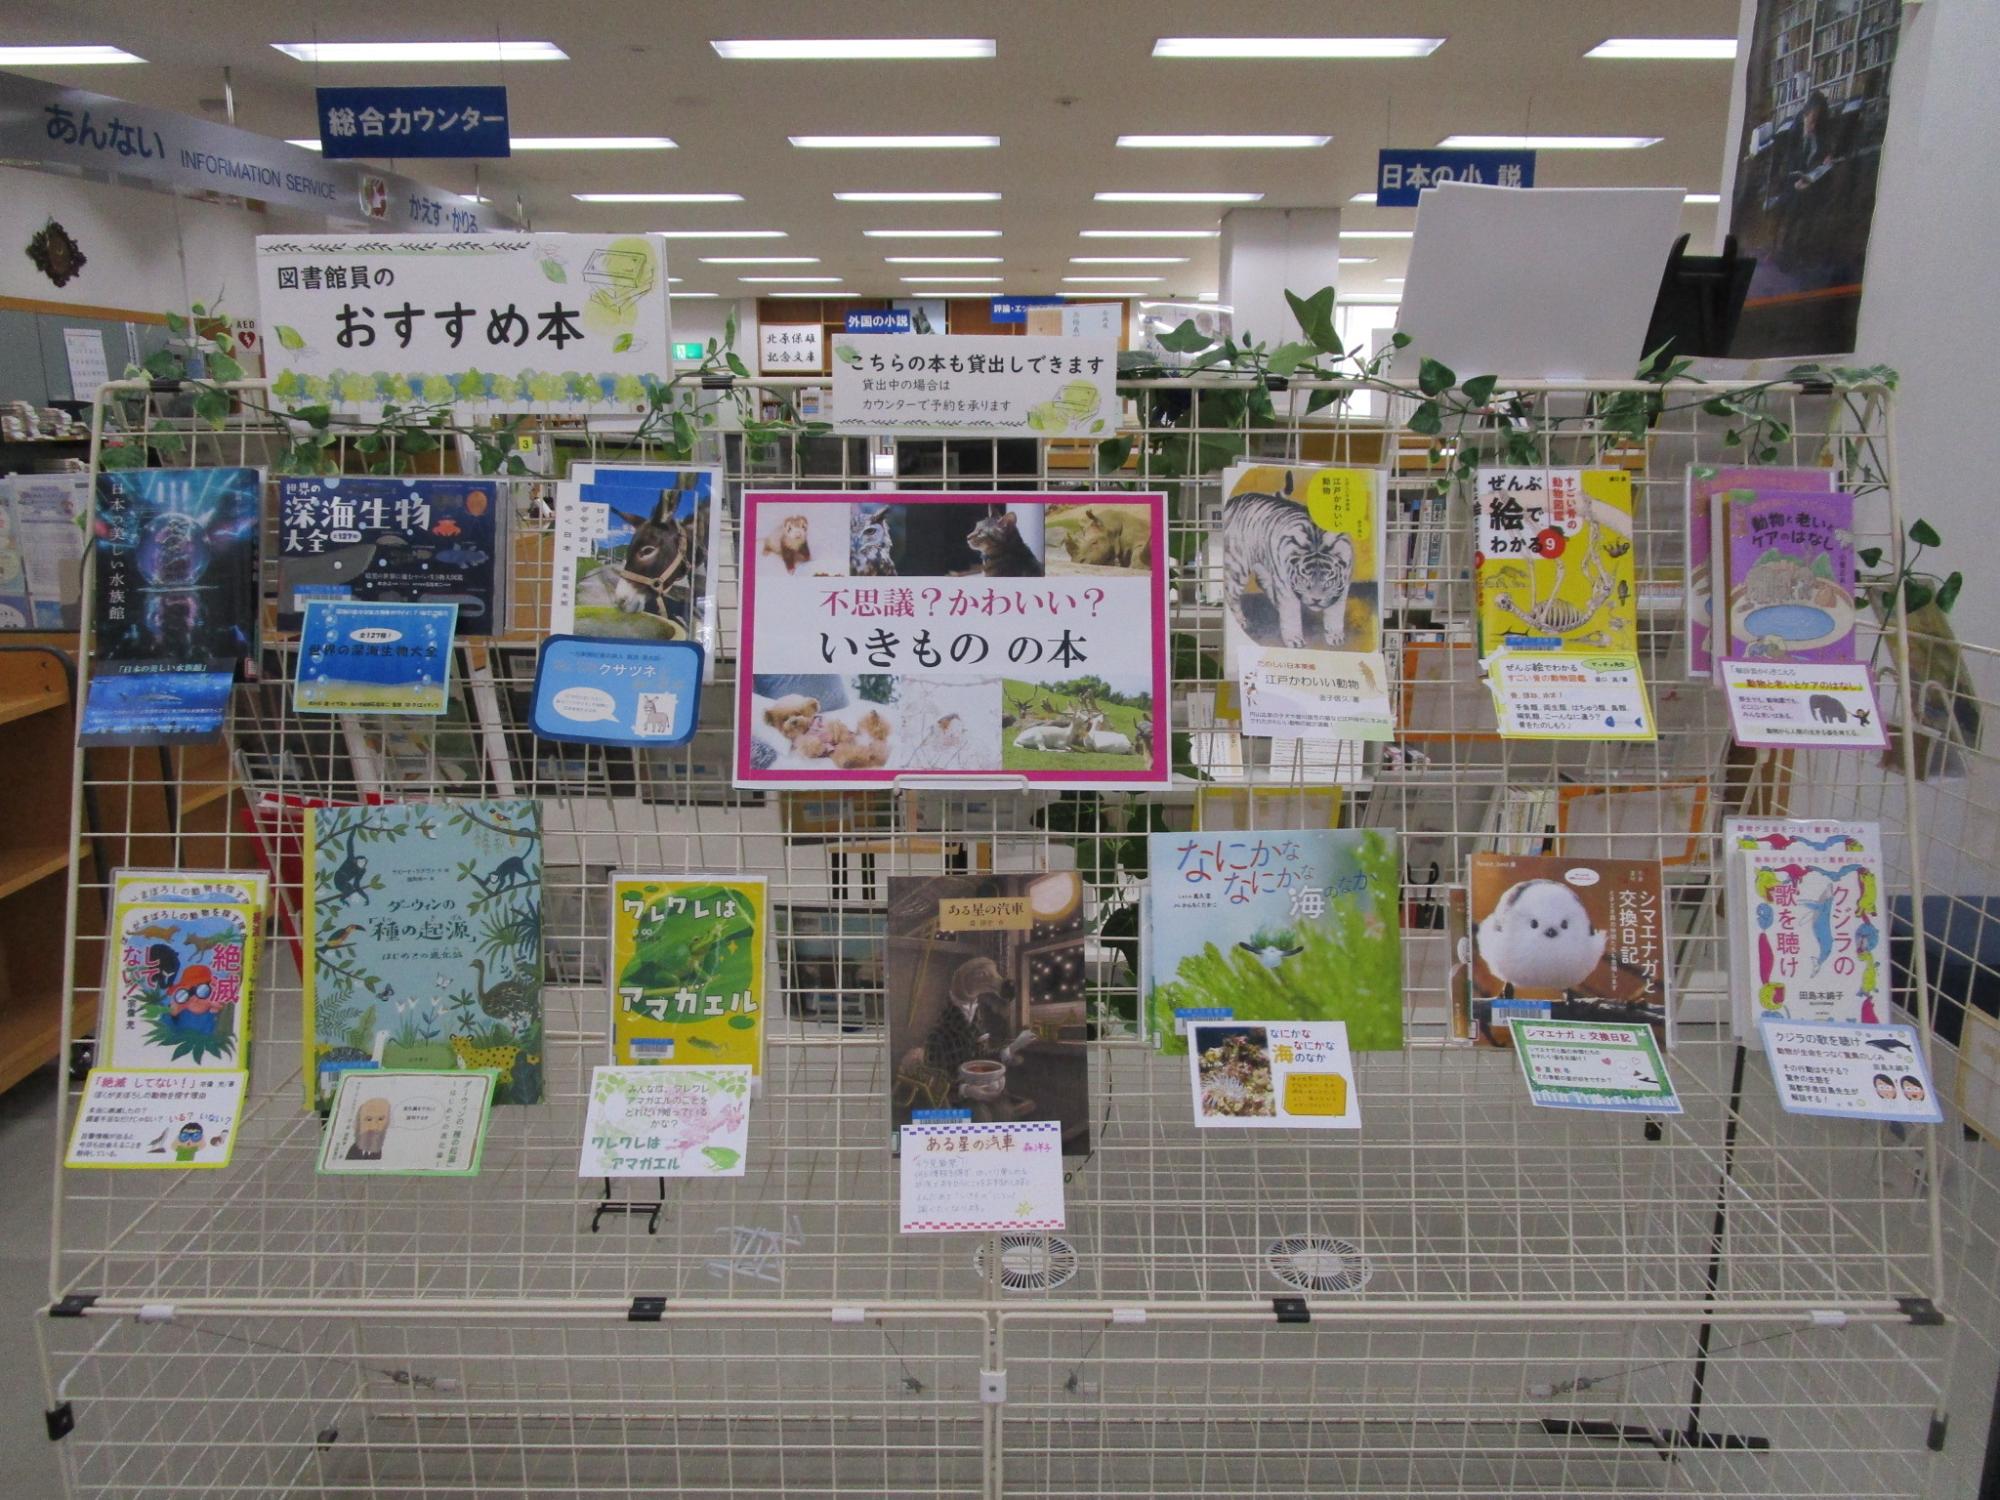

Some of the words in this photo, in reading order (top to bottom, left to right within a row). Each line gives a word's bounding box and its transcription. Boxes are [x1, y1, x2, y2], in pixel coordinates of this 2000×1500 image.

[44, 103, 166, 159] あんない
[327, 105, 505, 137] 総合カウンター
[180, 149, 281, 189] INFORMATION
[285, 173, 337, 201] SERVICE
[1382, 162, 1523, 189] 日本の小説
[408, 193, 478, 234] かえす・かりる
[277, 265, 396, 291] 図書館員の
[236, 320, 256, 329] AED
[334, 300, 586, 351] おすすめ本
[848, 314, 909, 329] 外国の小説
[767, 351, 816, 363] 記念文庫
[849, 353, 1106, 376] こちらの本も貸出しできます
[862, 378, 951, 392] 貸出中の場合は
[862, 398, 1011, 413] カウンターで予約を承ります
[522, 439, 530, 449] 3
[286, 482, 322, 496] 世界の
[1321, 477, 1331, 494] 動物
[1487, 474, 1543, 492] ぜんぶ
[283, 495, 432, 531] 深海生物
[1333, 477, 1343, 528] 江戸かわいい
[1489, 496, 1545, 531] 絵で
[1563, 476, 1578, 531] すごい骨の
[109, 482, 126, 621] 日本の美しい水族館
[283, 529, 329, 554] 大全
[1490, 535, 1544, 554] わかる
[1545, 538, 1556, 551] 9
[1751, 530, 1835, 551] ケアのはなし
[818, 586, 1106, 619] 不思議？かわいい？
[308, 643, 439, 658] 世界の深海生物大全
[599, 662, 657, 678] クサツネ
[1505, 661, 1579, 673] ぜんぶ絵でわかる
[1265, 674, 1360, 690] 江戸かわいい動物
[1507, 674, 1587, 683] すごい骨の動物図鑑
[1176, 838, 1301, 884] なにかな
[1223, 863, 1316, 906] なにかな
[386, 899, 456, 913] ダーウィンの
[623, 895, 737, 922] ワレワレは
[947, 900, 1025, 917] ある星の汽車
[367, 916, 478, 943] 「種の起源」
[1618, 890, 1640, 966] 交換日記
[1774, 884, 1801, 979] 歌を聴け
[1832, 885, 1855, 977] クジラの
[1639, 890, 1660, 995] シマエナガと
[120, 944, 144, 1001] ない！
[141, 945, 161, 990] して
[208, 943, 242, 1004] 絶滅
[618, 982, 760, 1022] アマガエル
[1270, 1029, 1312, 1039] なにかな
[1774, 1030, 1862, 1048] クジラの歌を聴け
[1293, 1040, 1336, 1051] なにかな
[625, 1096, 709, 1105] アマガエルのことを
[168, 1111, 195, 1124] いる？
[199, 1112, 233, 1126] いない？
[590, 1135, 661, 1150] ワレワレは
[926, 1134, 1017, 1153] ある星の汽車
[610, 1156, 681, 1171] アマガエル
